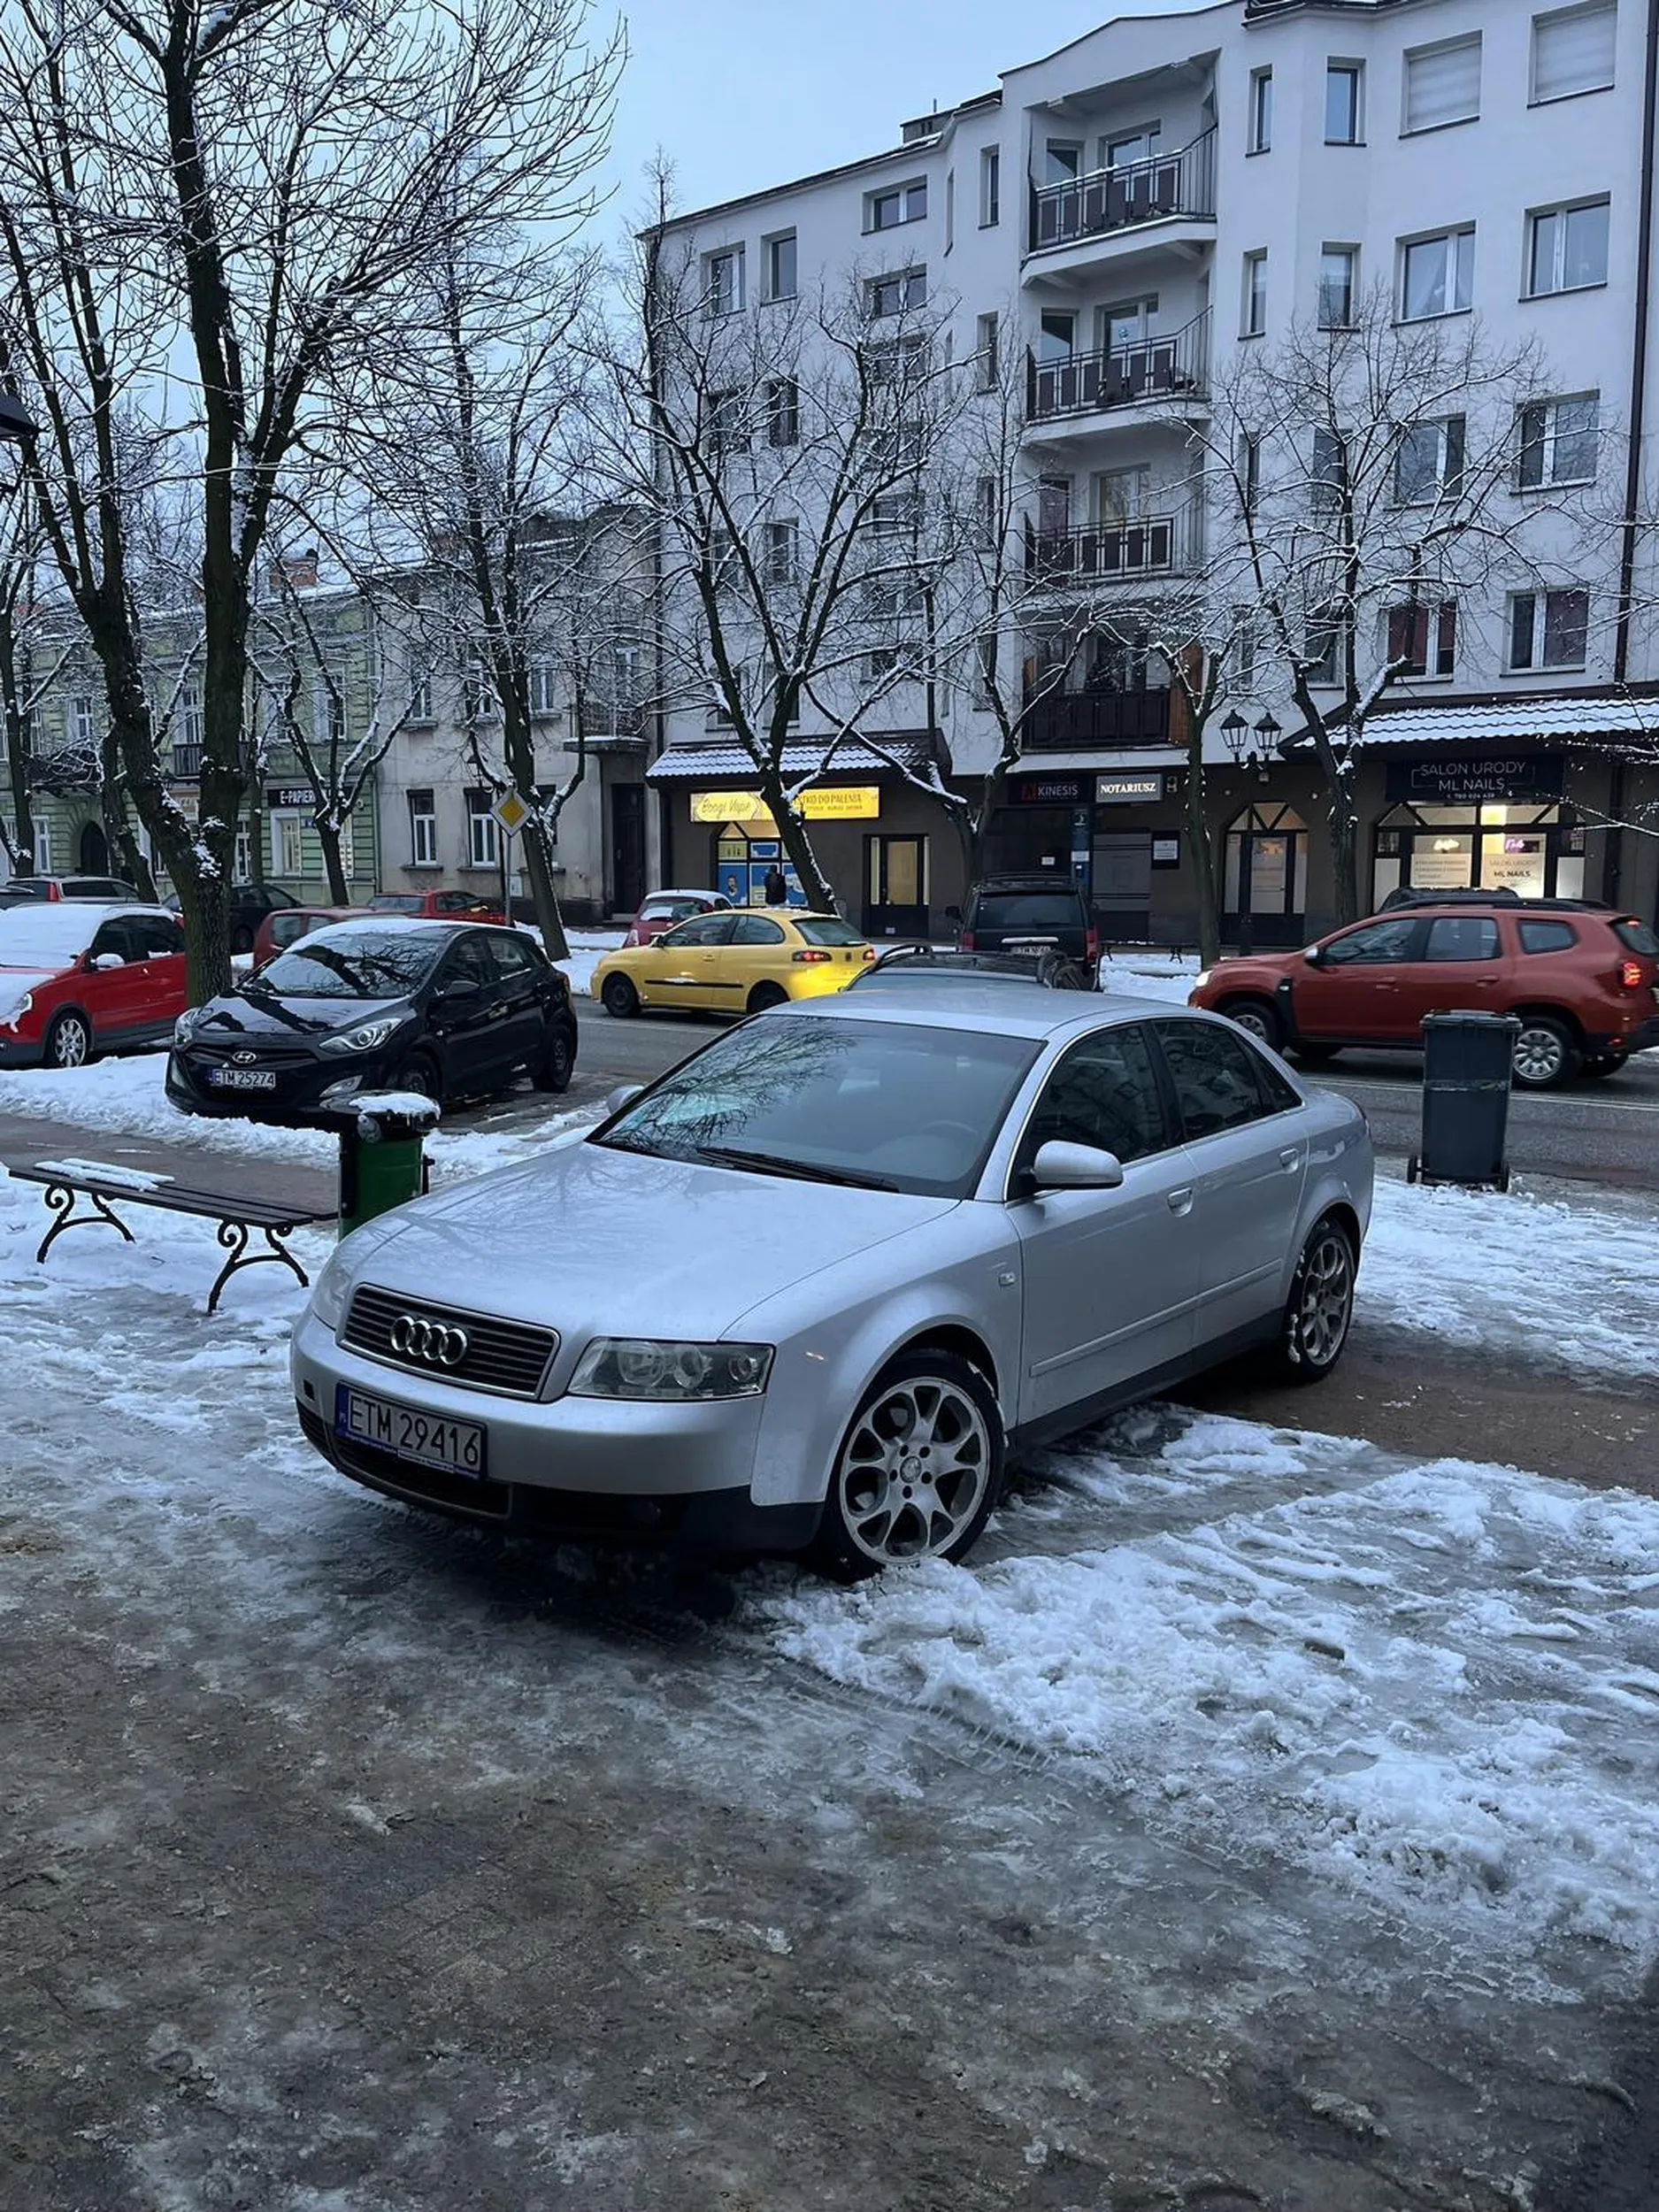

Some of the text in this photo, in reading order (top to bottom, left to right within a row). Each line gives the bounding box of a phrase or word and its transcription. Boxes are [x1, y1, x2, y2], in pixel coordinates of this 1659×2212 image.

[1420, 761, 1526, 777] SALON URODY
[1038, 785, 1079, 796] KINESIS
[1100, 782, 1156, 794] NOTARIUSZ
[1439, 778, 1505, 792] ML NAILS
[280, 790, 316, 804] E-PAPIER
[350, 1394, 391, 1442] ETM
[400, 1413, 479, 1465] 29416
